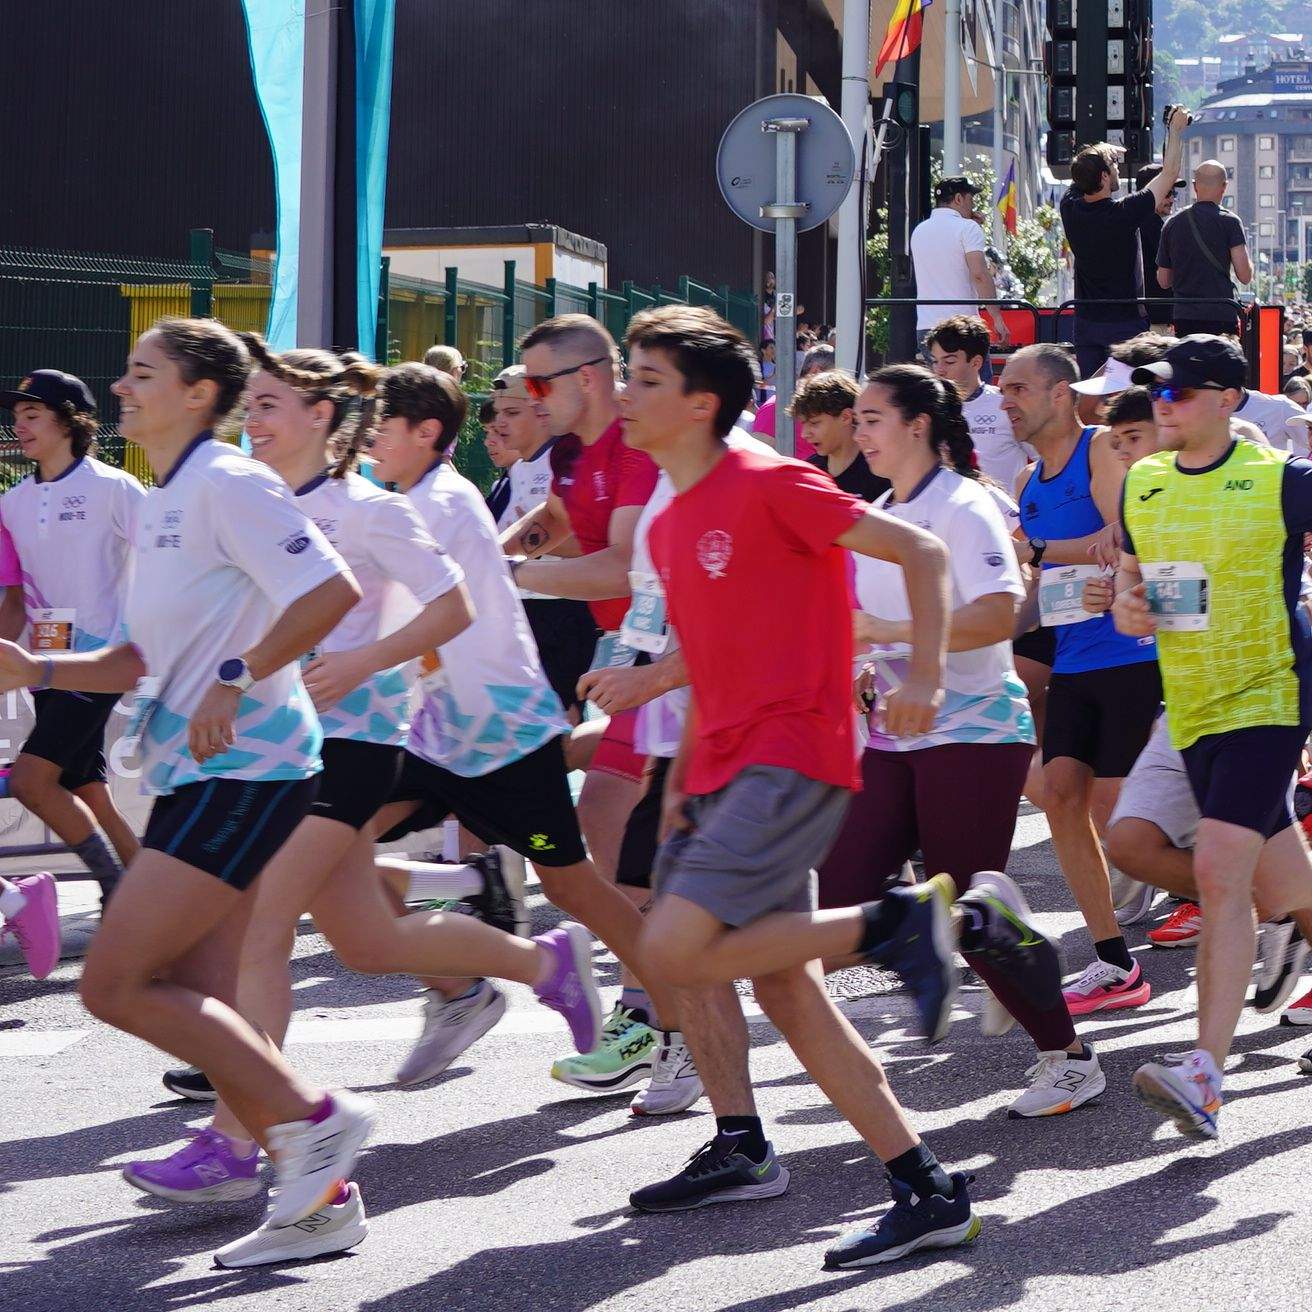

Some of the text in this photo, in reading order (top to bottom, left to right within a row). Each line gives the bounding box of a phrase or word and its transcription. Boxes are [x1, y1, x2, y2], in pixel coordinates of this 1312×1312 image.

[1276, 74, 1310, 84] HOTEL
[1222, 478, 1254, 491] AND
[1064, 583, 1074, 599] 8
[619, 1031, 655, 1062] HOKA
